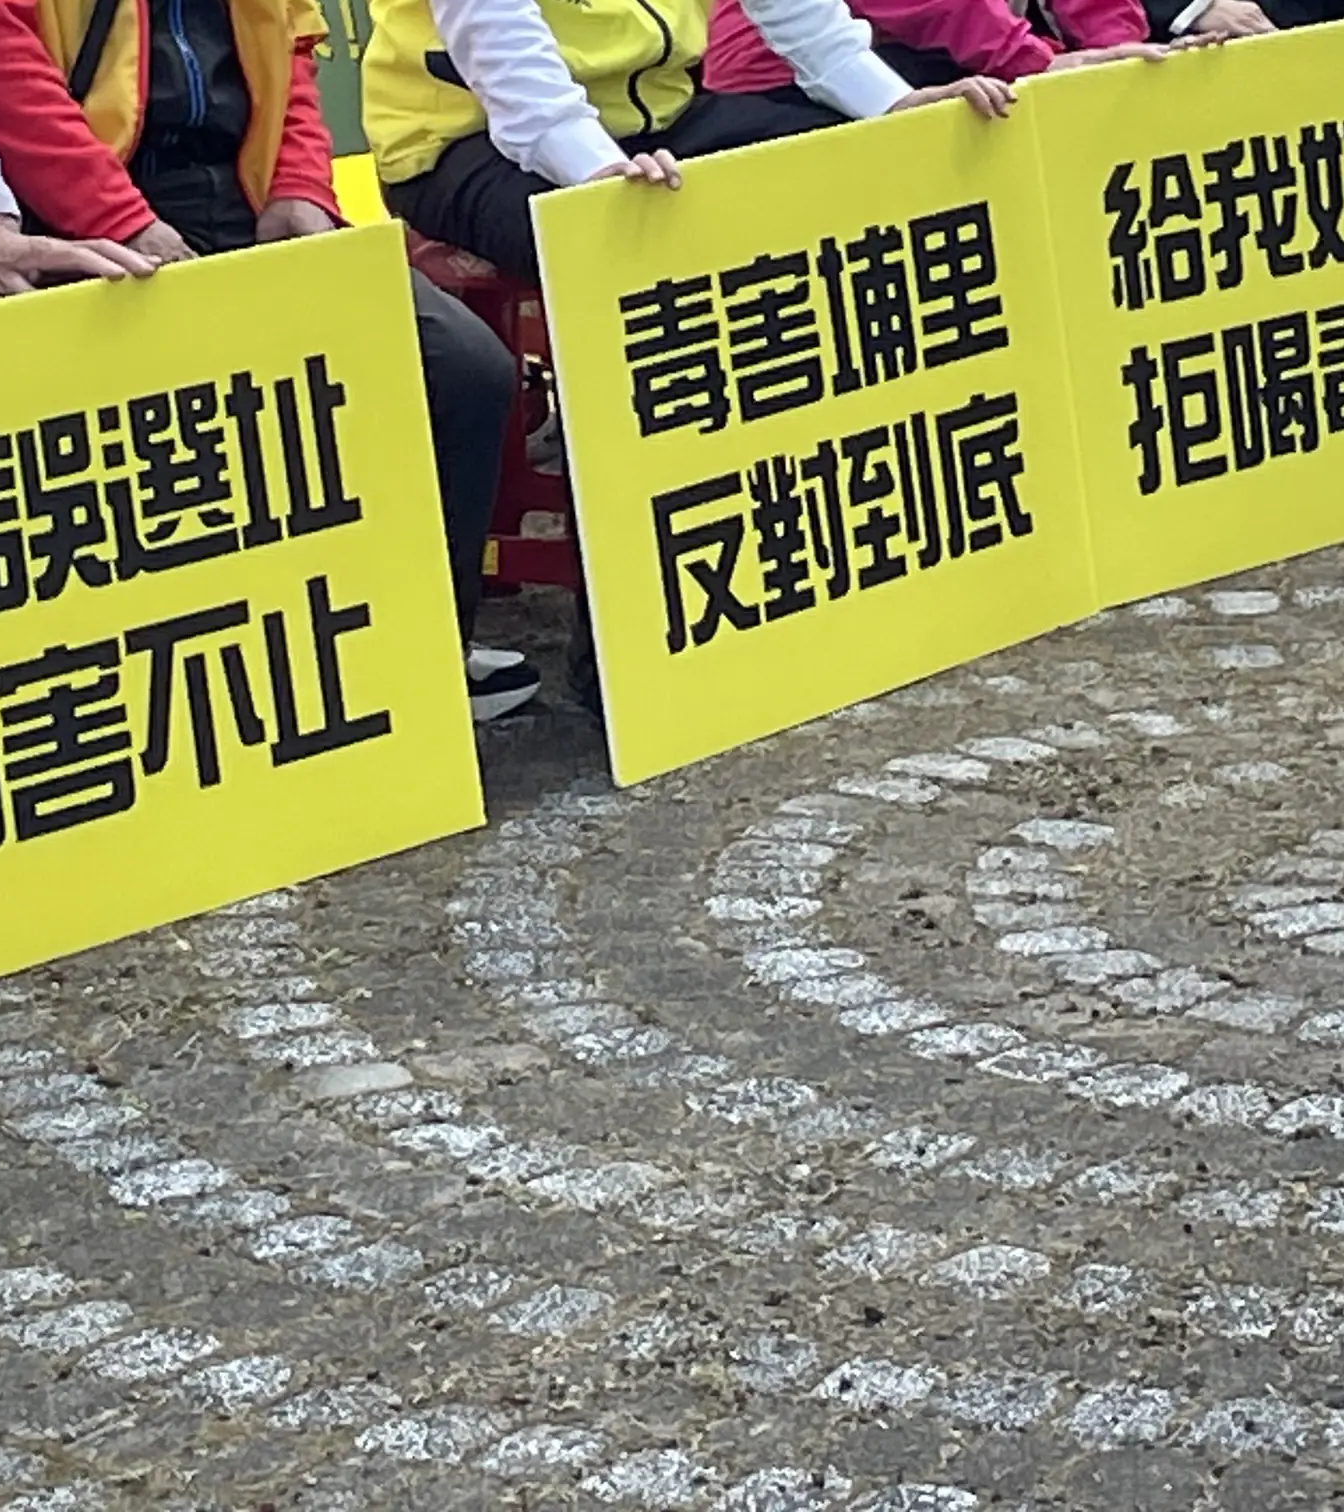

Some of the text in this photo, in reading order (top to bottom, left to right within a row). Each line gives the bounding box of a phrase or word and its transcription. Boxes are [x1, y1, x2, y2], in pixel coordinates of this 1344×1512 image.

[618, 200, 1010, 438] 毒害埔里
[650, 391, 1034, 655] 反對到底
